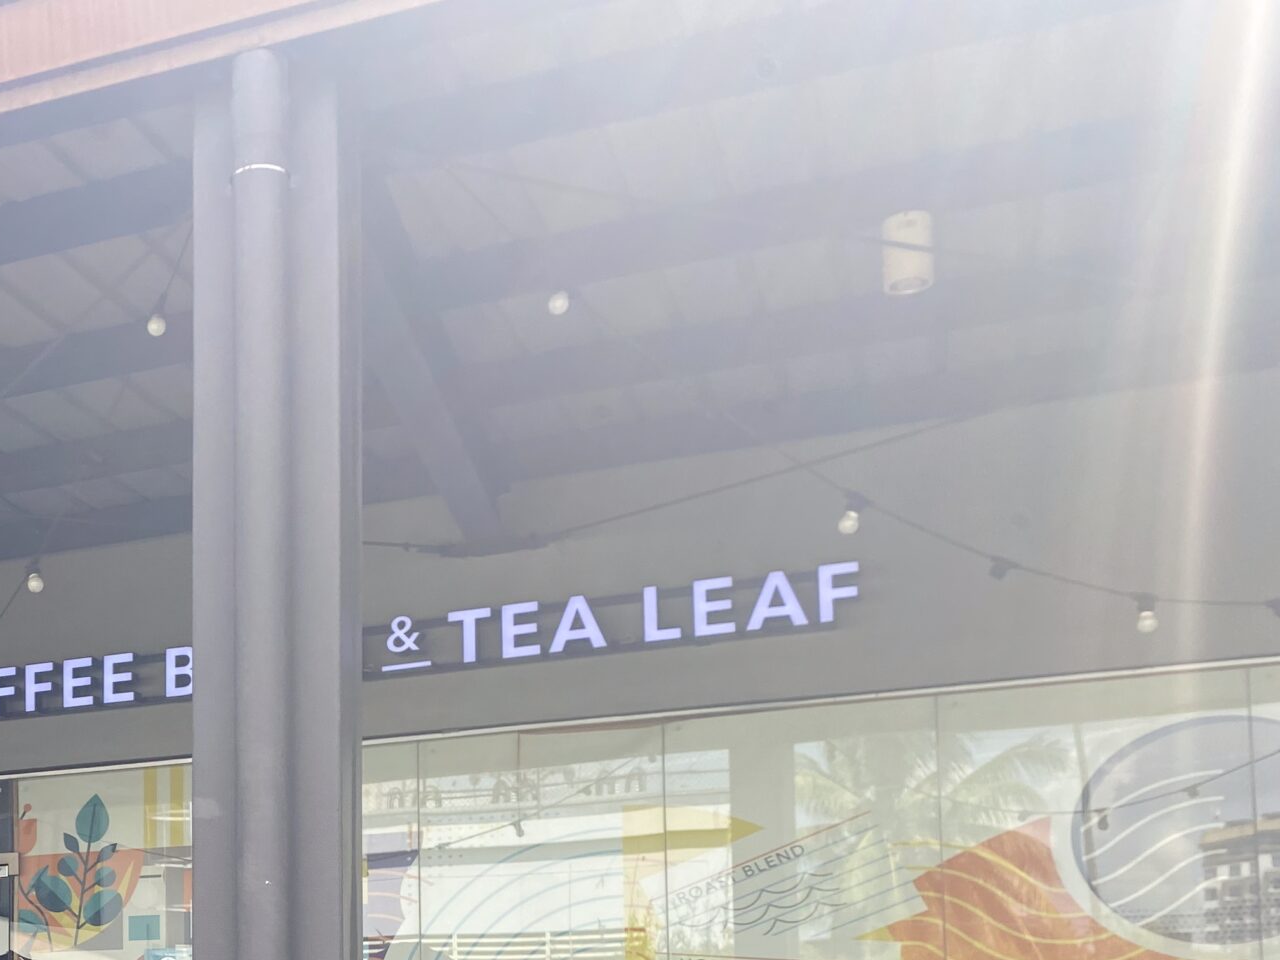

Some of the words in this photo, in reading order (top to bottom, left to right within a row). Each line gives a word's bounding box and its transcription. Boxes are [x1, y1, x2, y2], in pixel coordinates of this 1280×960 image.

[386, 615, 420, 653] &
[448, 595, 608, 663] TEA
[643, 561, 860, 643] LEAF
[742, 845, 805, 878] BLEND
